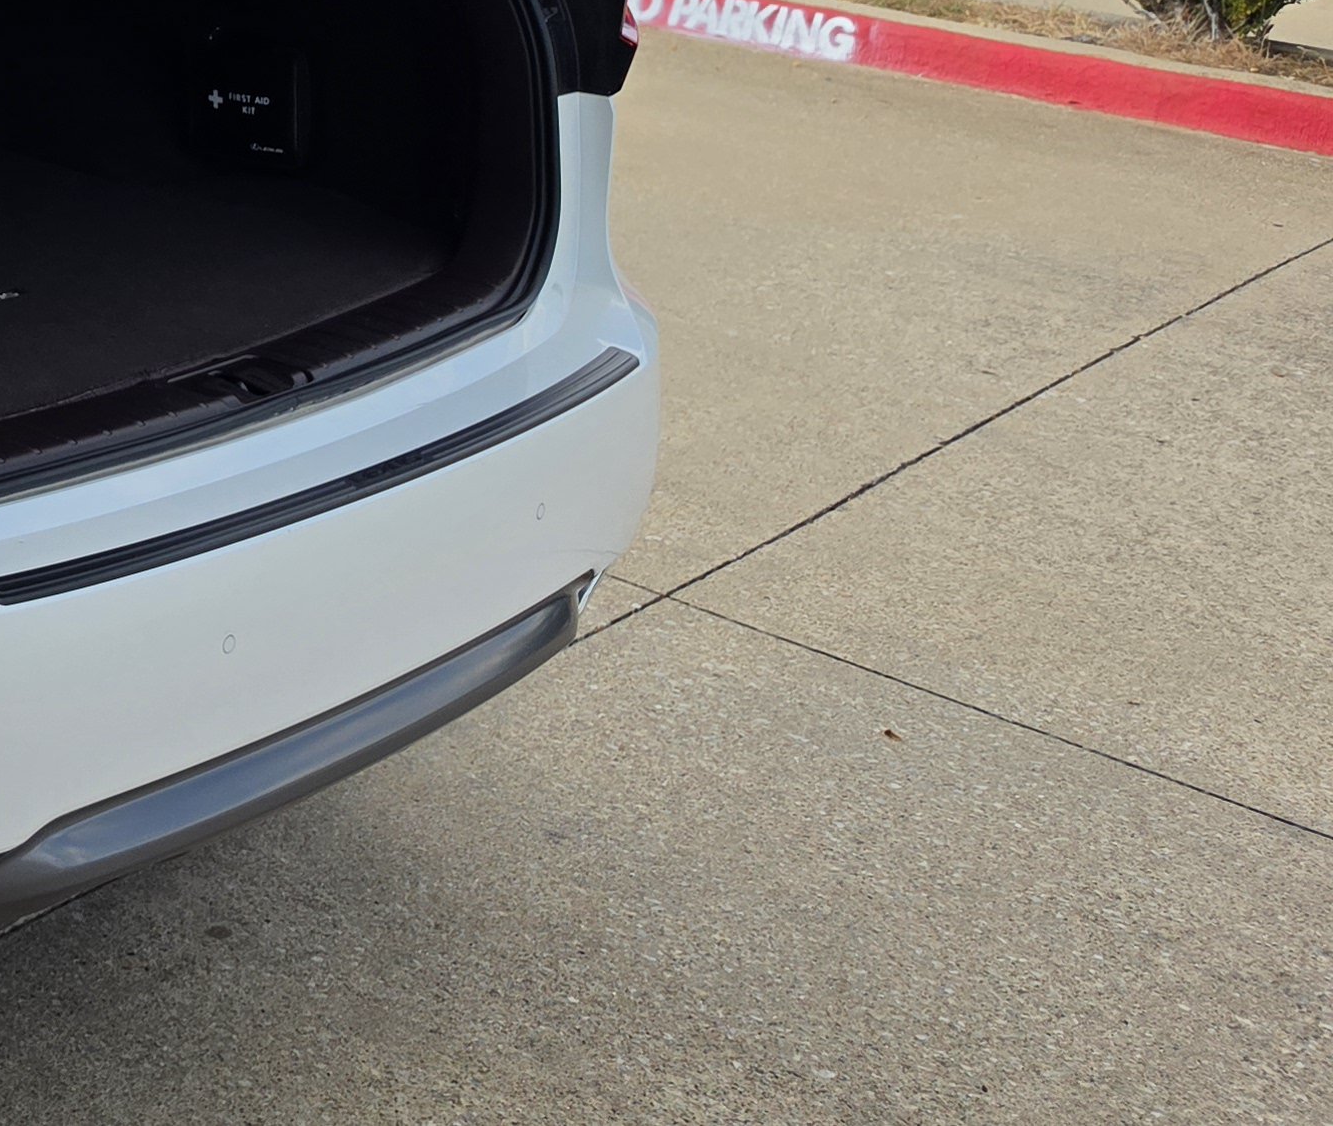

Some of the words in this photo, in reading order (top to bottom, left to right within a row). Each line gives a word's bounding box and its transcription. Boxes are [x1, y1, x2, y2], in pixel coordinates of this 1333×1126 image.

[229, 92, 251, 103] FIRST
[254, 96, 270, 105] AID
[242, 106, 255, 115] KIT
